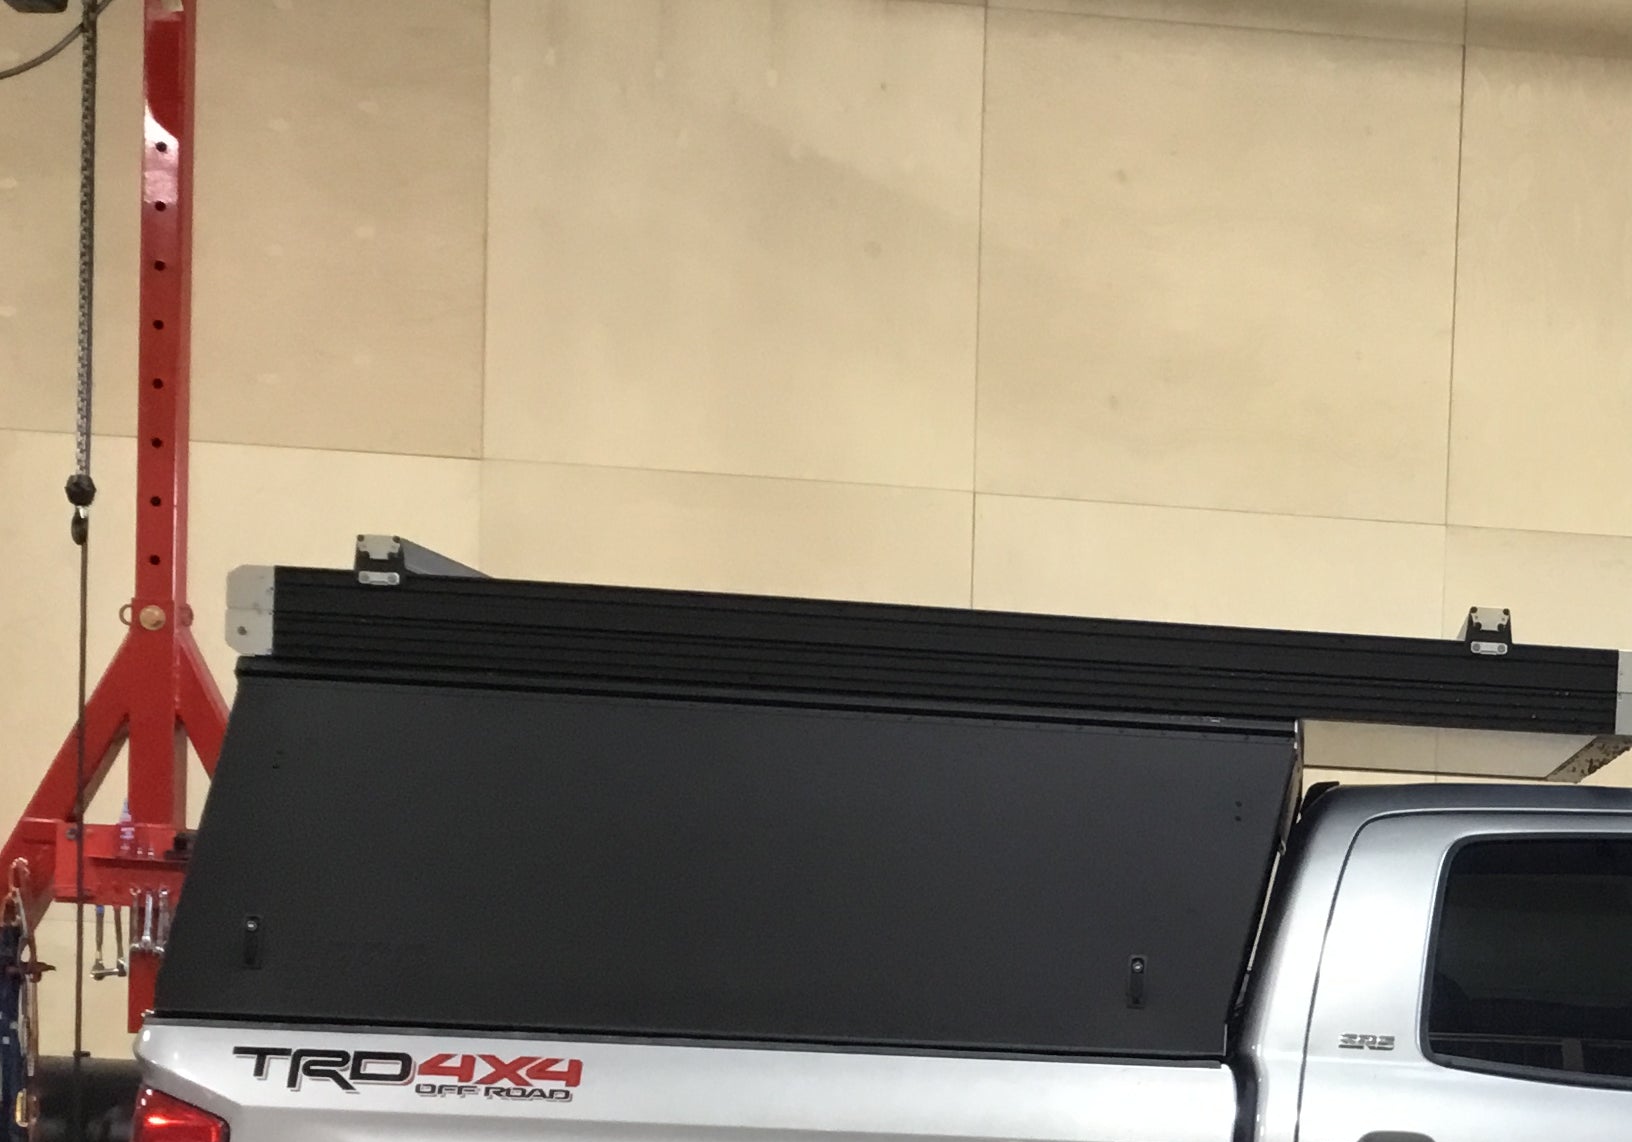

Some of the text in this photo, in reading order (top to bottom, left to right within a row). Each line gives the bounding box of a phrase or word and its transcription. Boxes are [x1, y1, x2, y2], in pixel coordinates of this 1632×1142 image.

[233, 1046, 414, 1094] TRD
[414, 1083, 574, 1102] OFF ROAD
